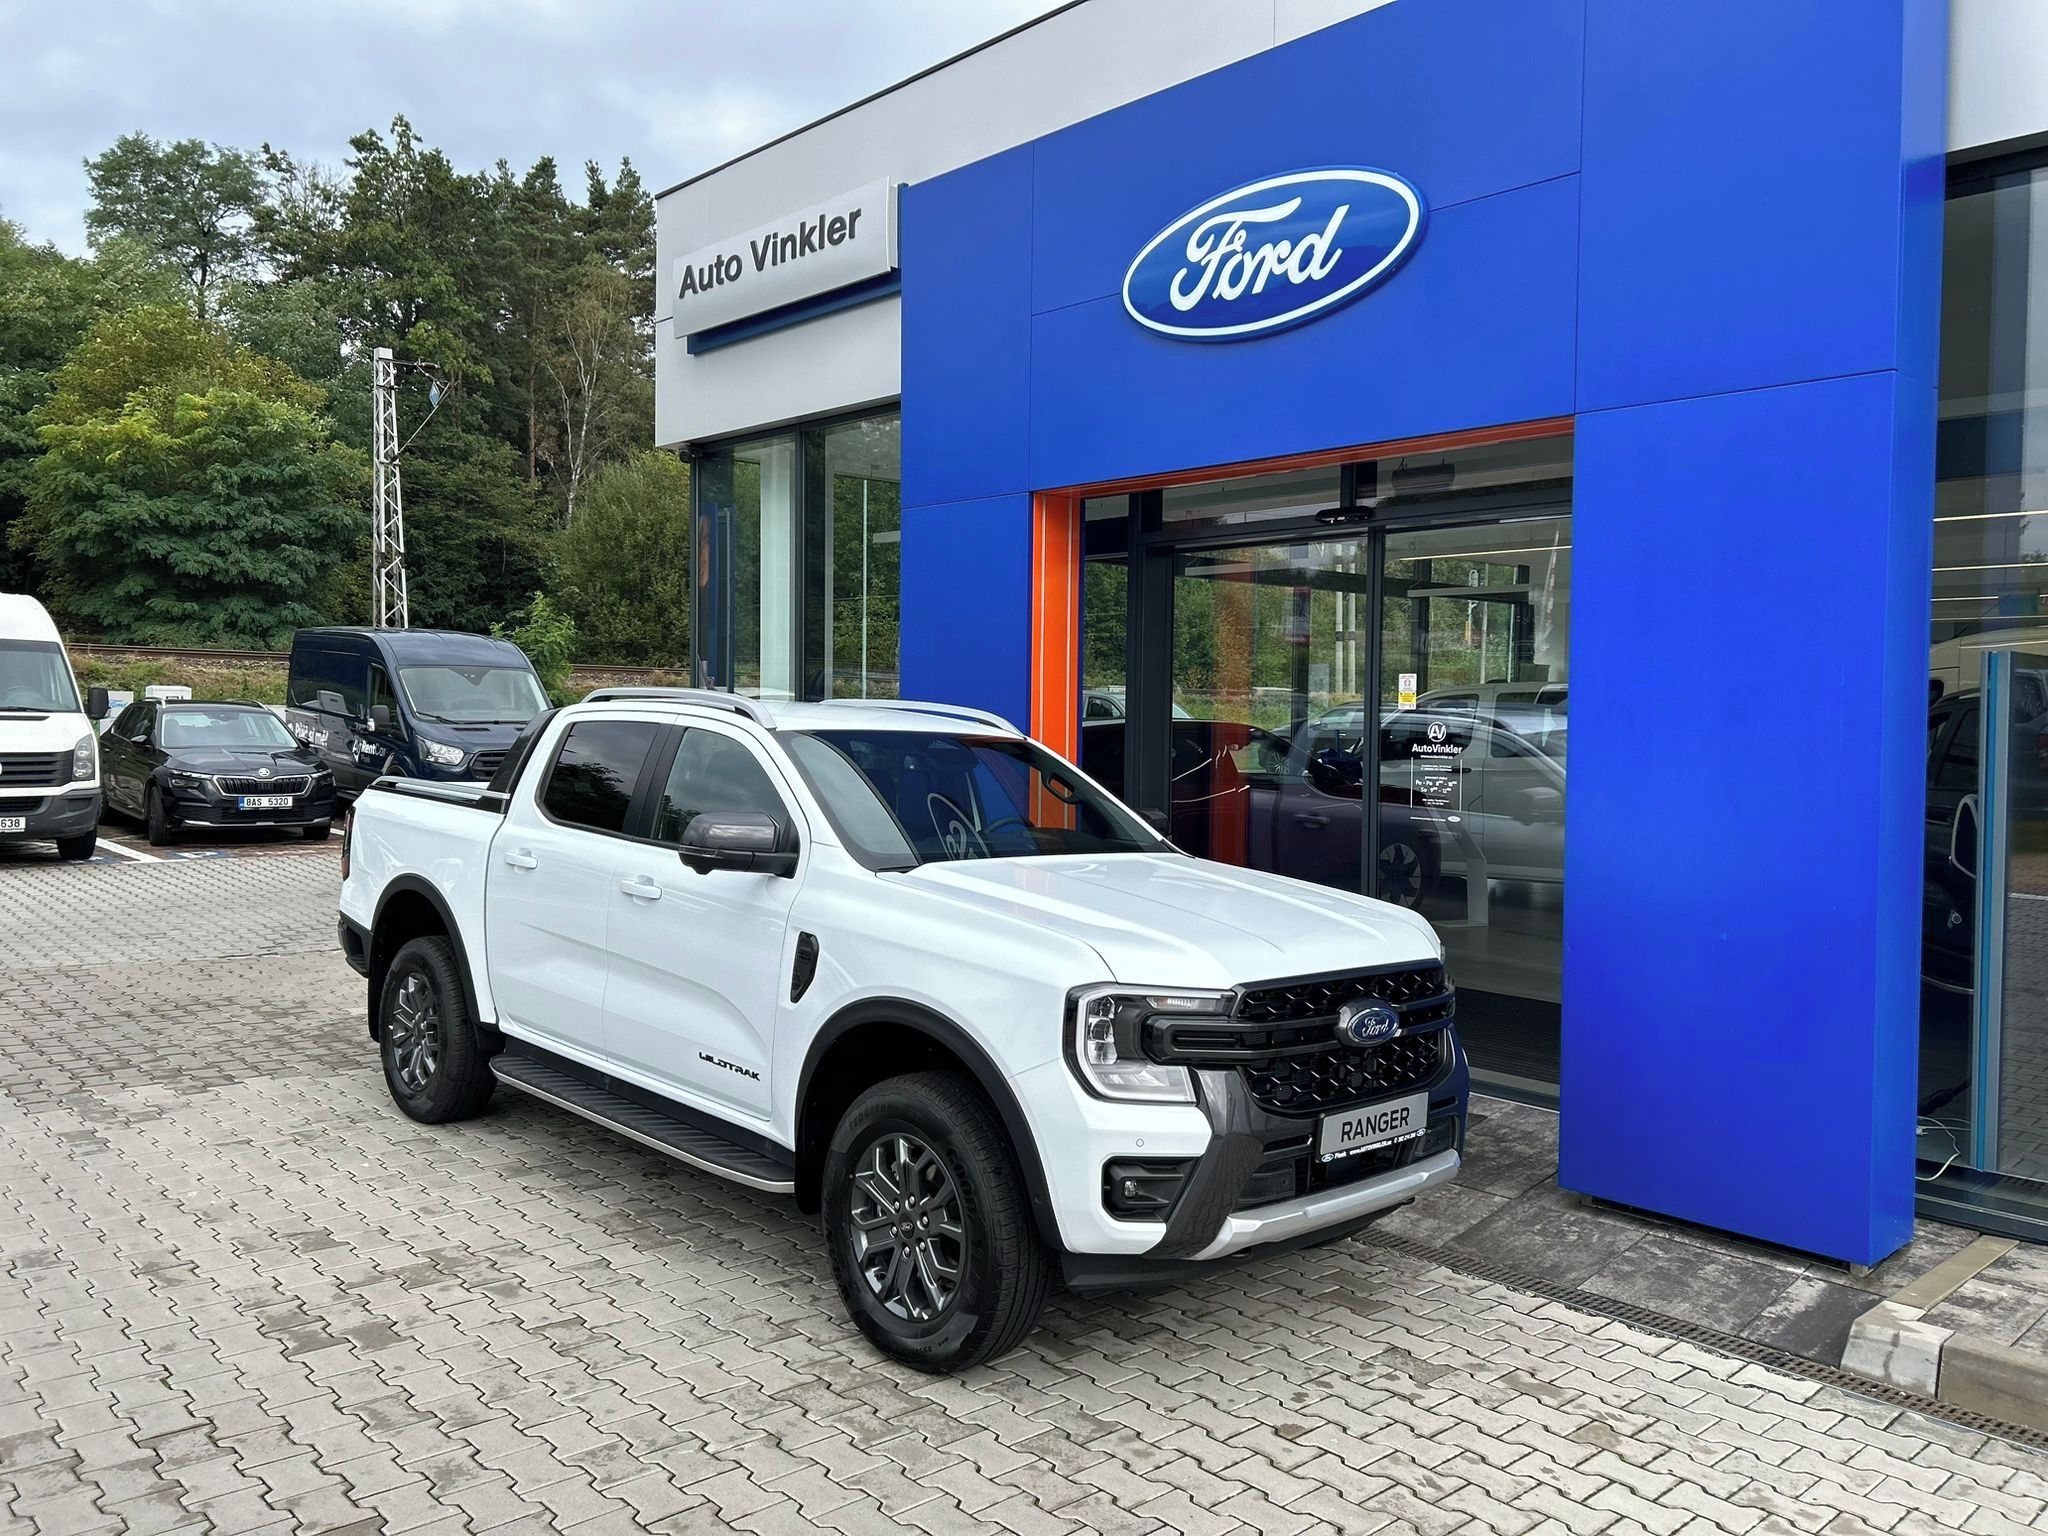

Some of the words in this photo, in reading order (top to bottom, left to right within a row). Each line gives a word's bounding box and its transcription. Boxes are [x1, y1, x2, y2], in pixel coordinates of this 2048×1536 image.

[678, 254, 743, 300] Auto
[750, 208, 862, 272] Vinkler
[1169, 196, 1350, 312] Ford
[1411, 743, 1463, 754] AutoVinkler
[268, 797, 289, 806] 5320
[0, 818, 21, 828] 638
[1362, 1016, 1389, 1038] Ford
[699, 1051, 761, 1082] WILDTRAK
[1340, 1106, 1411, 1143] RANGER
